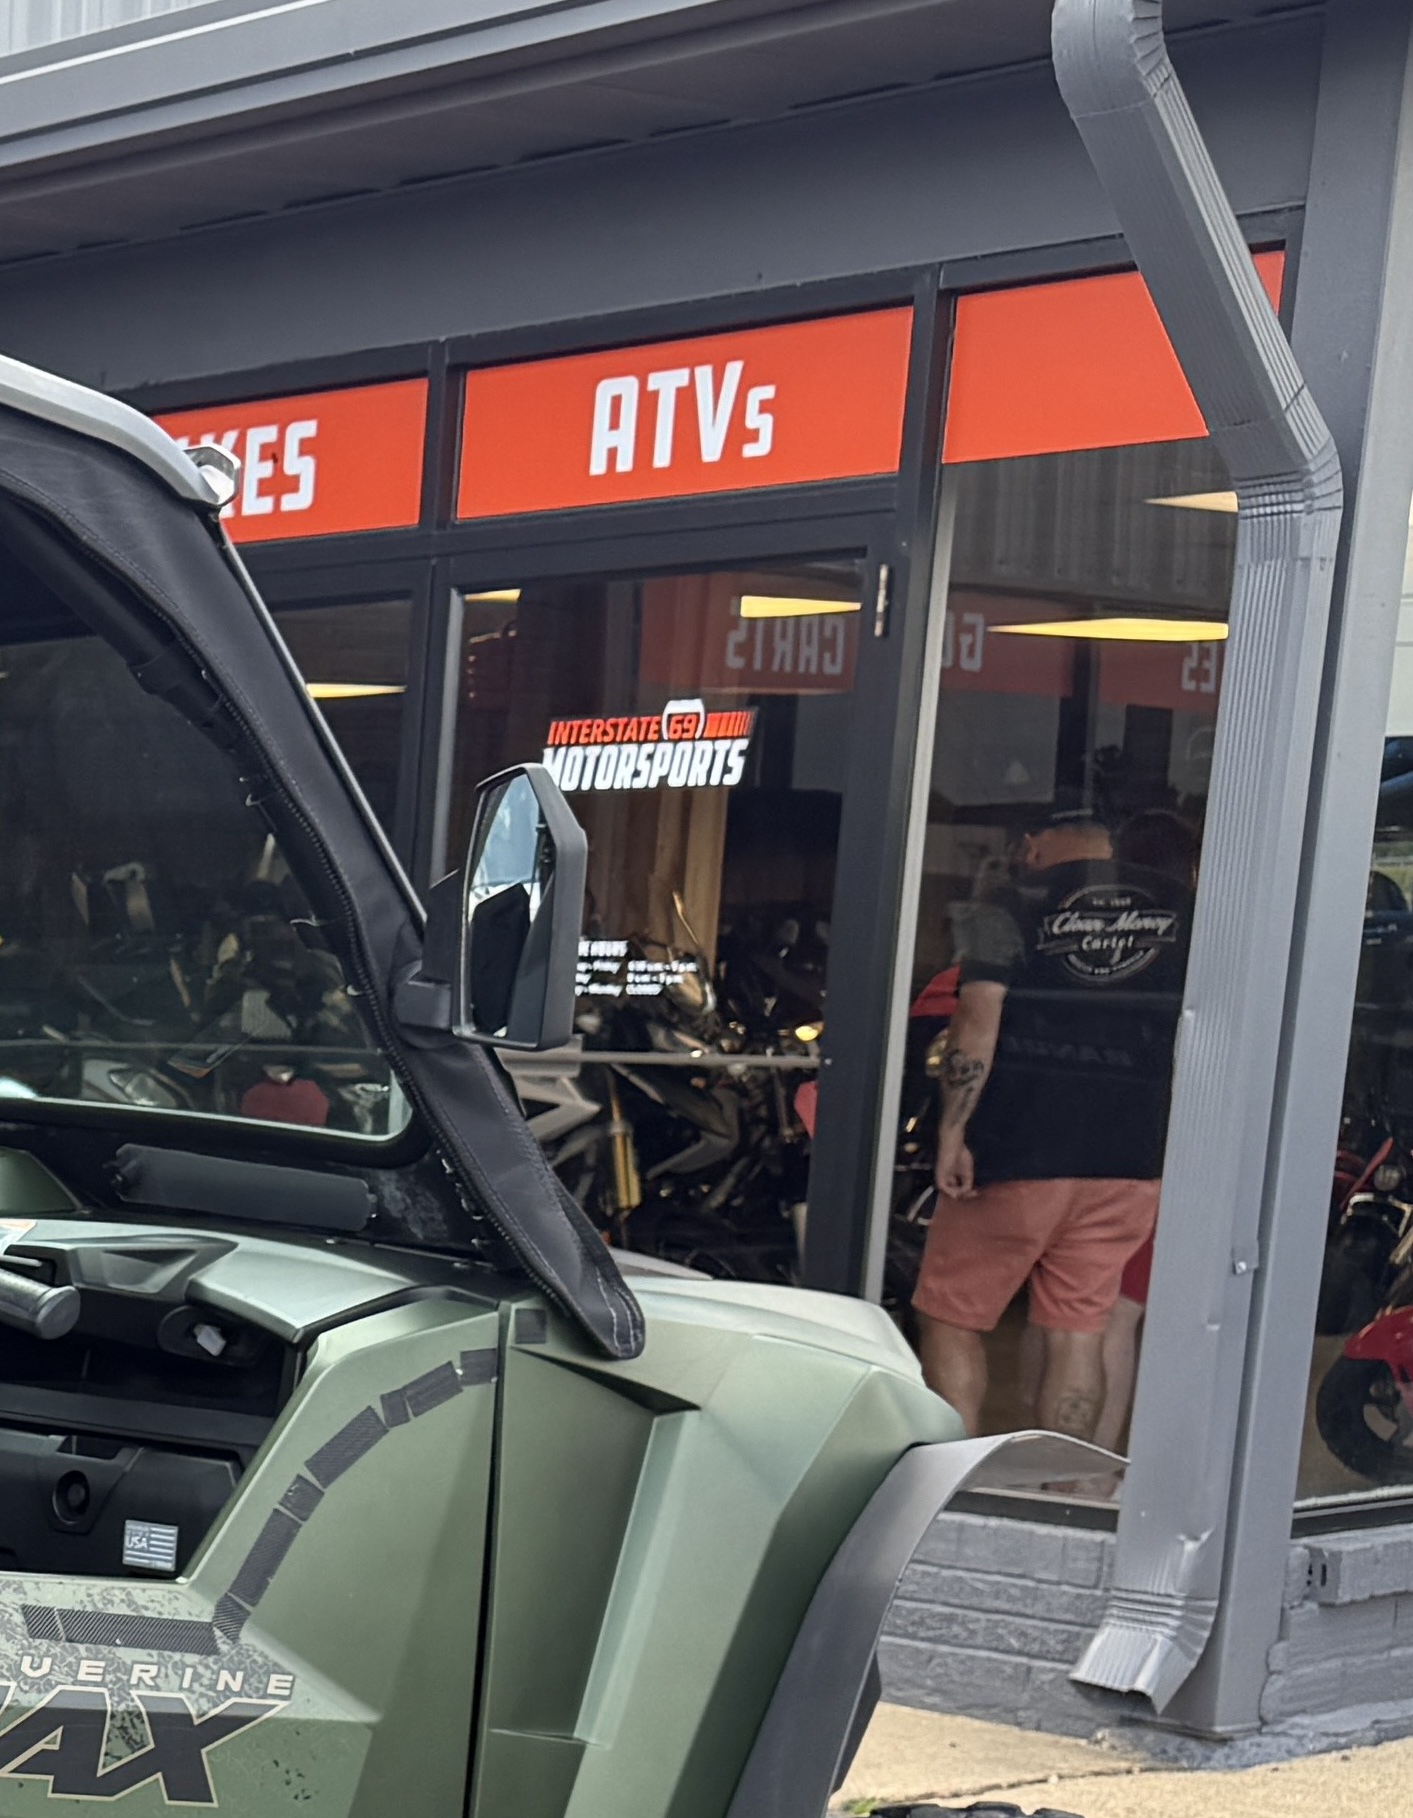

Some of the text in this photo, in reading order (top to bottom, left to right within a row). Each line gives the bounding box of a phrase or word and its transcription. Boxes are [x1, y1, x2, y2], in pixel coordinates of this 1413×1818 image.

[589, 360, 776, 476] ATVs
[547, 713, 700, 746] INTERSTATE 69
[543, 738, 750, 792] MOTORSPORTS
